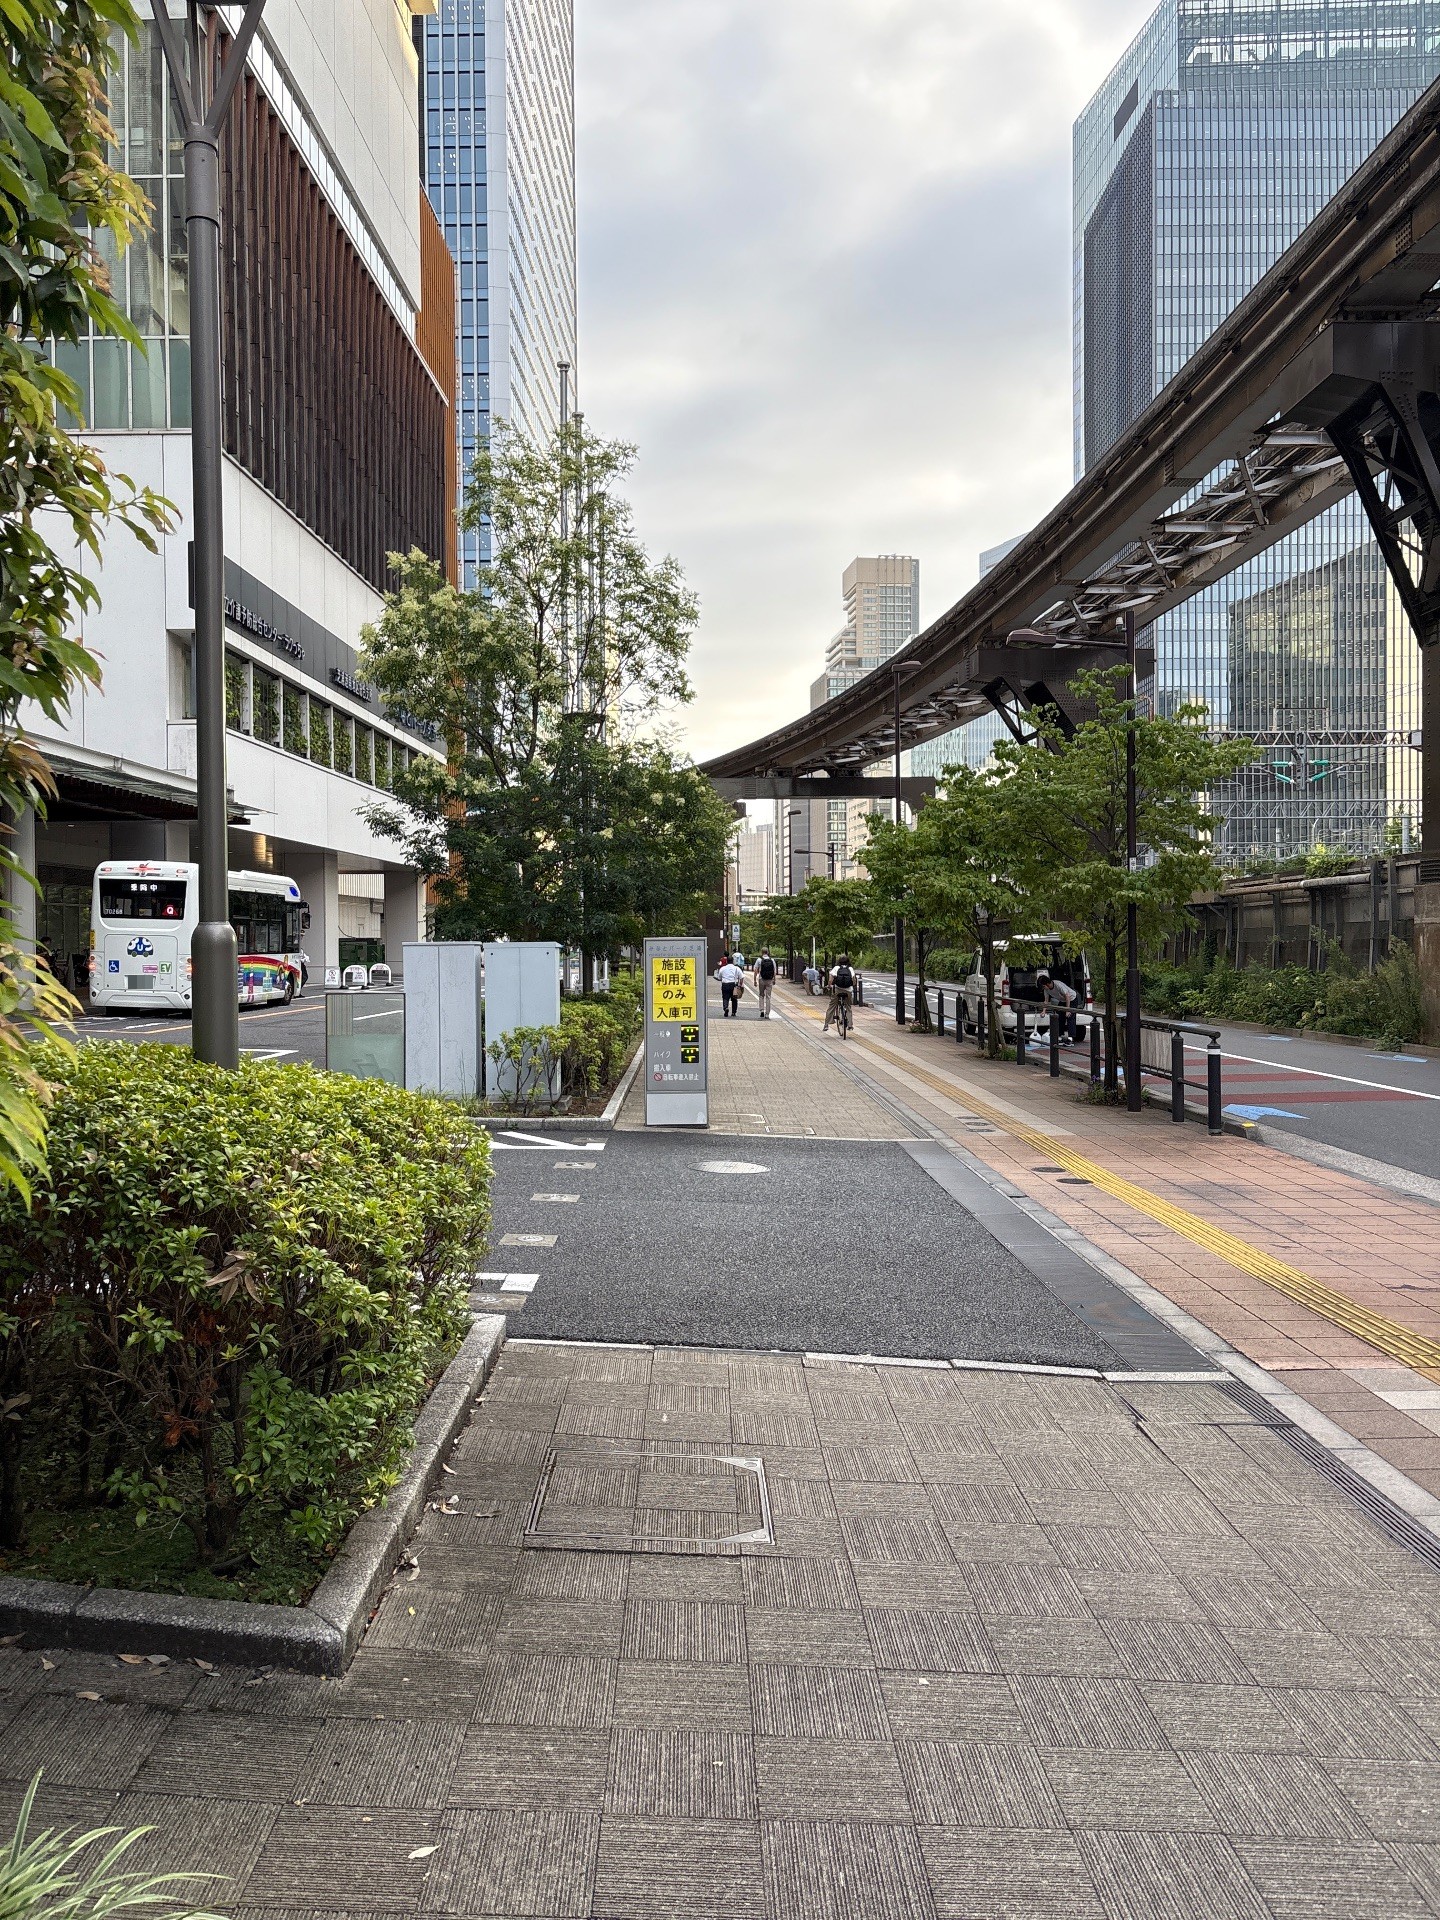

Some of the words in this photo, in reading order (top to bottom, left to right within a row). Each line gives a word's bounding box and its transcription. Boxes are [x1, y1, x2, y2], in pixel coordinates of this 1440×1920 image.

[160, 963, 171, 973] EV
[661, 958, 687, 971] 施設
[655, 973, 693, 986] 利用者
[662, 989, 687, 1000] のみ
[656, 1006, 693, 1019] 入庫可
